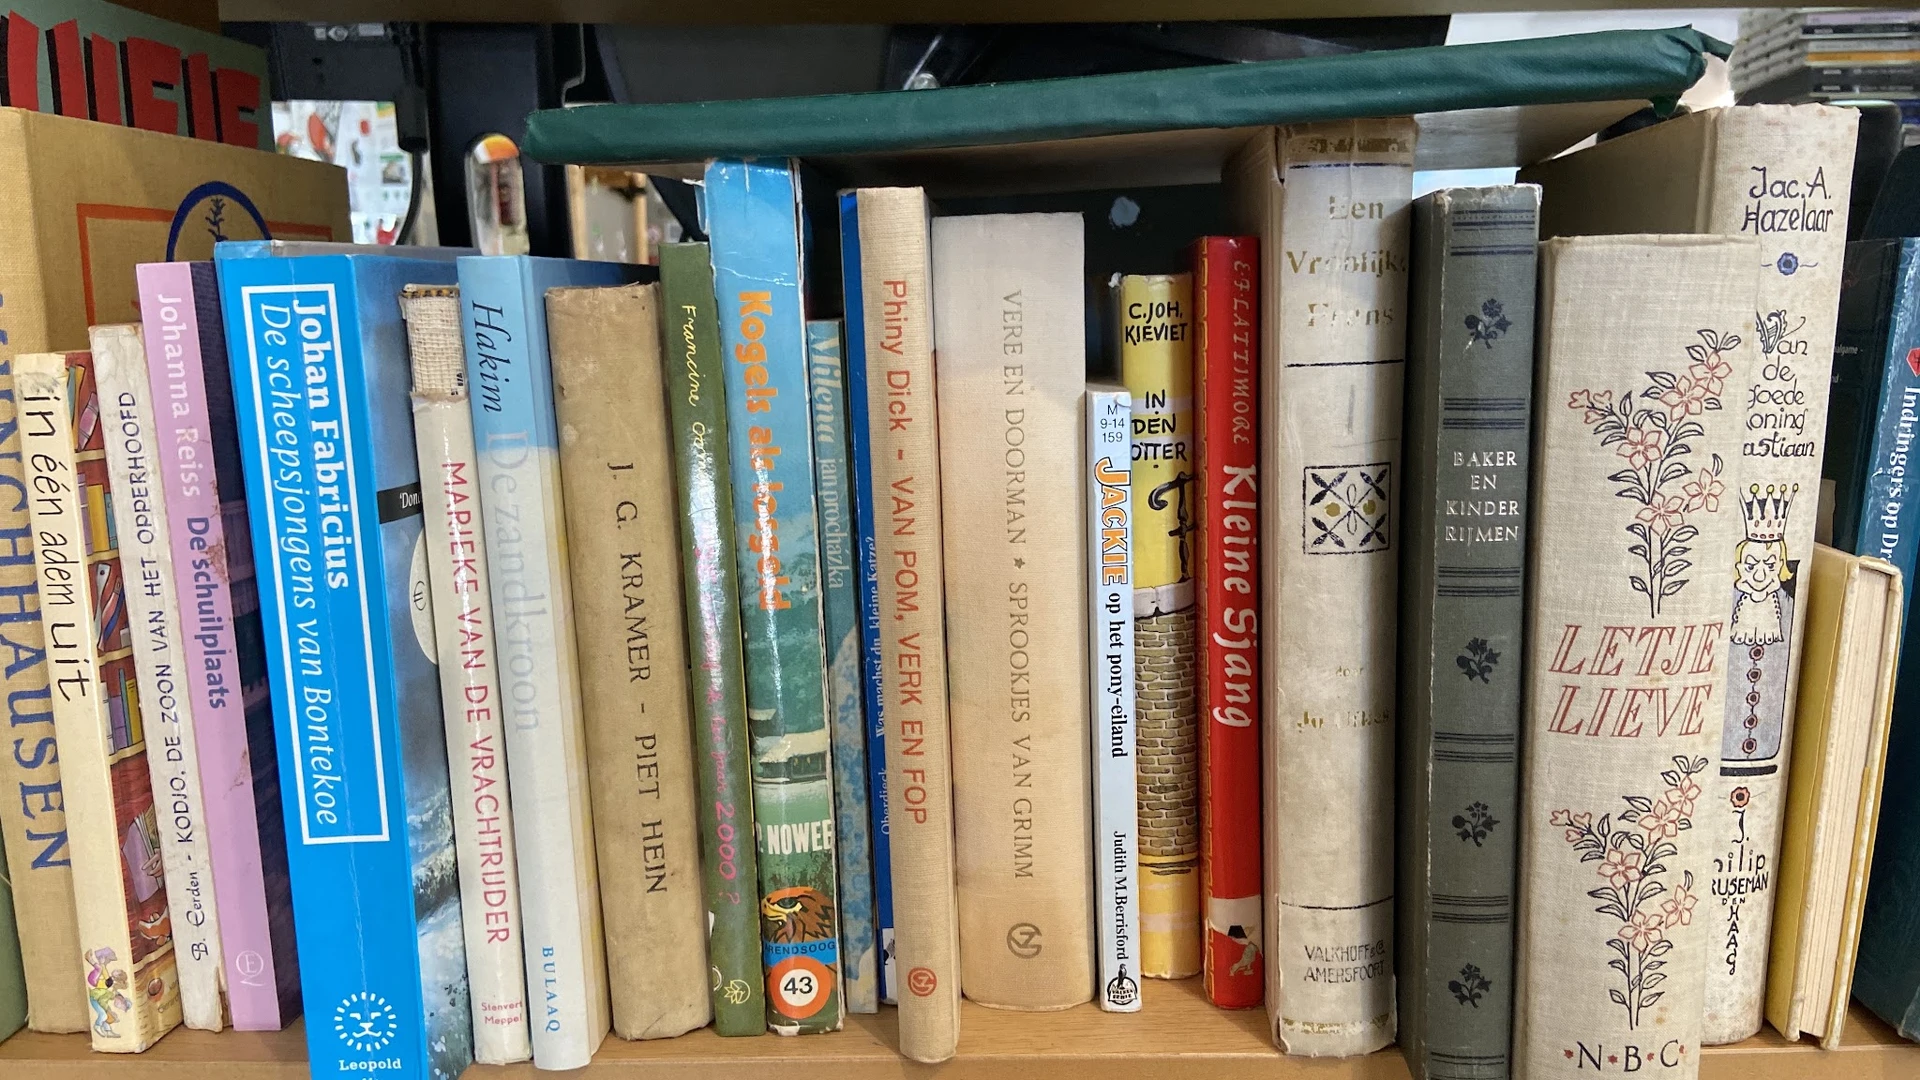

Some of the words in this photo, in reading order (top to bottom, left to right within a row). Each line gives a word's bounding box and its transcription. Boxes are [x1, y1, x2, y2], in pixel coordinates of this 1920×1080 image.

[1741, 199, 1834, 235] Hazelaar
[260, 303, 291, 348] De
[881, 280, 907, 356] Phiny
[1002, 289, 1023, 356] VERE
[1125, 324, 1188, 346] KIEVIET
[1756, 309, 1808, 360] Van
[293, 299, 332, 410] Johan
[471, 301, 512, 413] Hakim
[681, 305, 706, 408] Francine
[734, 290, 773, 413] Kogels
[1762, 355, 1796, 382] de
[157, 294, 190, 418] Johanna
[175, 427, 201, 498] Reiss
[809, 332, 844, 443] Milena
[887, 370, 913, 432] Dick
[1003, 365, 1025, 397] EN
[1145, 388, 1166, 409] IN
[24, 395, 61, 437] in
[1100, 417, 1125, 430] 9-14
[1101, 432, 1123, 444] 159
[1107, 404, 1119, 416] M
[1131, 413, 1177, 435] DEN
[1745, 408, 1809, 436] oning
[118, 392, 155, 545] OPPERHOOFD
[486, 430, 529, 495] De
[748, 426, 782, 471] als
[1452, 450, 1518, 468] BAKER
[1742, 431, 1815, 458] astiaan
[1888, 386, 1920, 501] Indringers
[31, 452, 72, 516] één
[266, 356, 318, 609] scheepsjongens
[816, 457, 845, 488] jan
[1004, 408, 1028, 545] DOORMAN
[1470, 474, 1497, 491] EN
[311, 419, 352, 590] Fabricius
[441, 462, 479, 595] MARIEKE
[615, 501, 639, 531] G.
[891, 476, 916, 536] VAN
[1094, 456, 1132, 586] JACKIE
[1222, 464, 1258, 596] Kleine
[1445, 500, 1520, 517] KINDER
[1881, 503, 1901, 530] op
[186, 517, 210, 551] De
[817, 490, 851, 589] procházka
[1444, 525, 1520, 546] RIJMEN
[39, 531, 80, 606] adem
[144, 558, 163, 597] HET
[893, 551, 920, 621] POM,
[148, 610, 169, 651] VAN
[493, 503, 549, 734] zandkroon
[619, 551, 652, 683] KRAMER
[1105, 592, 1122, 615] op
[50, 621, 91, 702] uit
[190, 557, 227, 710] schuilplaats
[297, 619, 323, 676] van
[457, 607, 486, 670] VAN
[1009, 582, 1031, 724] SPROOKJES
[1109, 619, 1126, 649] het
[1548, 622, 1724, 677] LETJE
[155, 664, 180, 723] ZOON
[897, 632, 924, 706] VERK
[1212, 606, 1258, 729] Sjang
[464, 685, 491, 724] DE
[1106, 653, 1129, 759] pony-eiland
[1548, 684, 1713, 738] LIEVE
[164, 736, 183, 762] DE
[303, 686, 342, 826] Bontekoe
[634, 733, 661, 800] PIET
[900, 720, 925, 757] EN
[1012, 735, 1033, 789] VAN
[903, 769, 928, 826] FOP
[471, 735, 511, 944] VRACHTRIJDER
[641, 819, 668, 894] HEIN
[715, 801, 737, 881] 2000
[1013, 797, 1034, 879] GRIMM
[1113, 831, 1128, 874] Judith
[186, 871, 206, 927] Eerden
[1722, 897, 1746, 906] DEN
[542, 946, 562, 1033] BULAAQ
[783, 976, 814, 996] 43
[1303, 959, 1385, 984] AMERSFOORT
[481, 1000, 524, 1013] Stenvert
[484, 1013, 523, 1027] Meppel
[338, 1057, 402, 1072] Leopold
